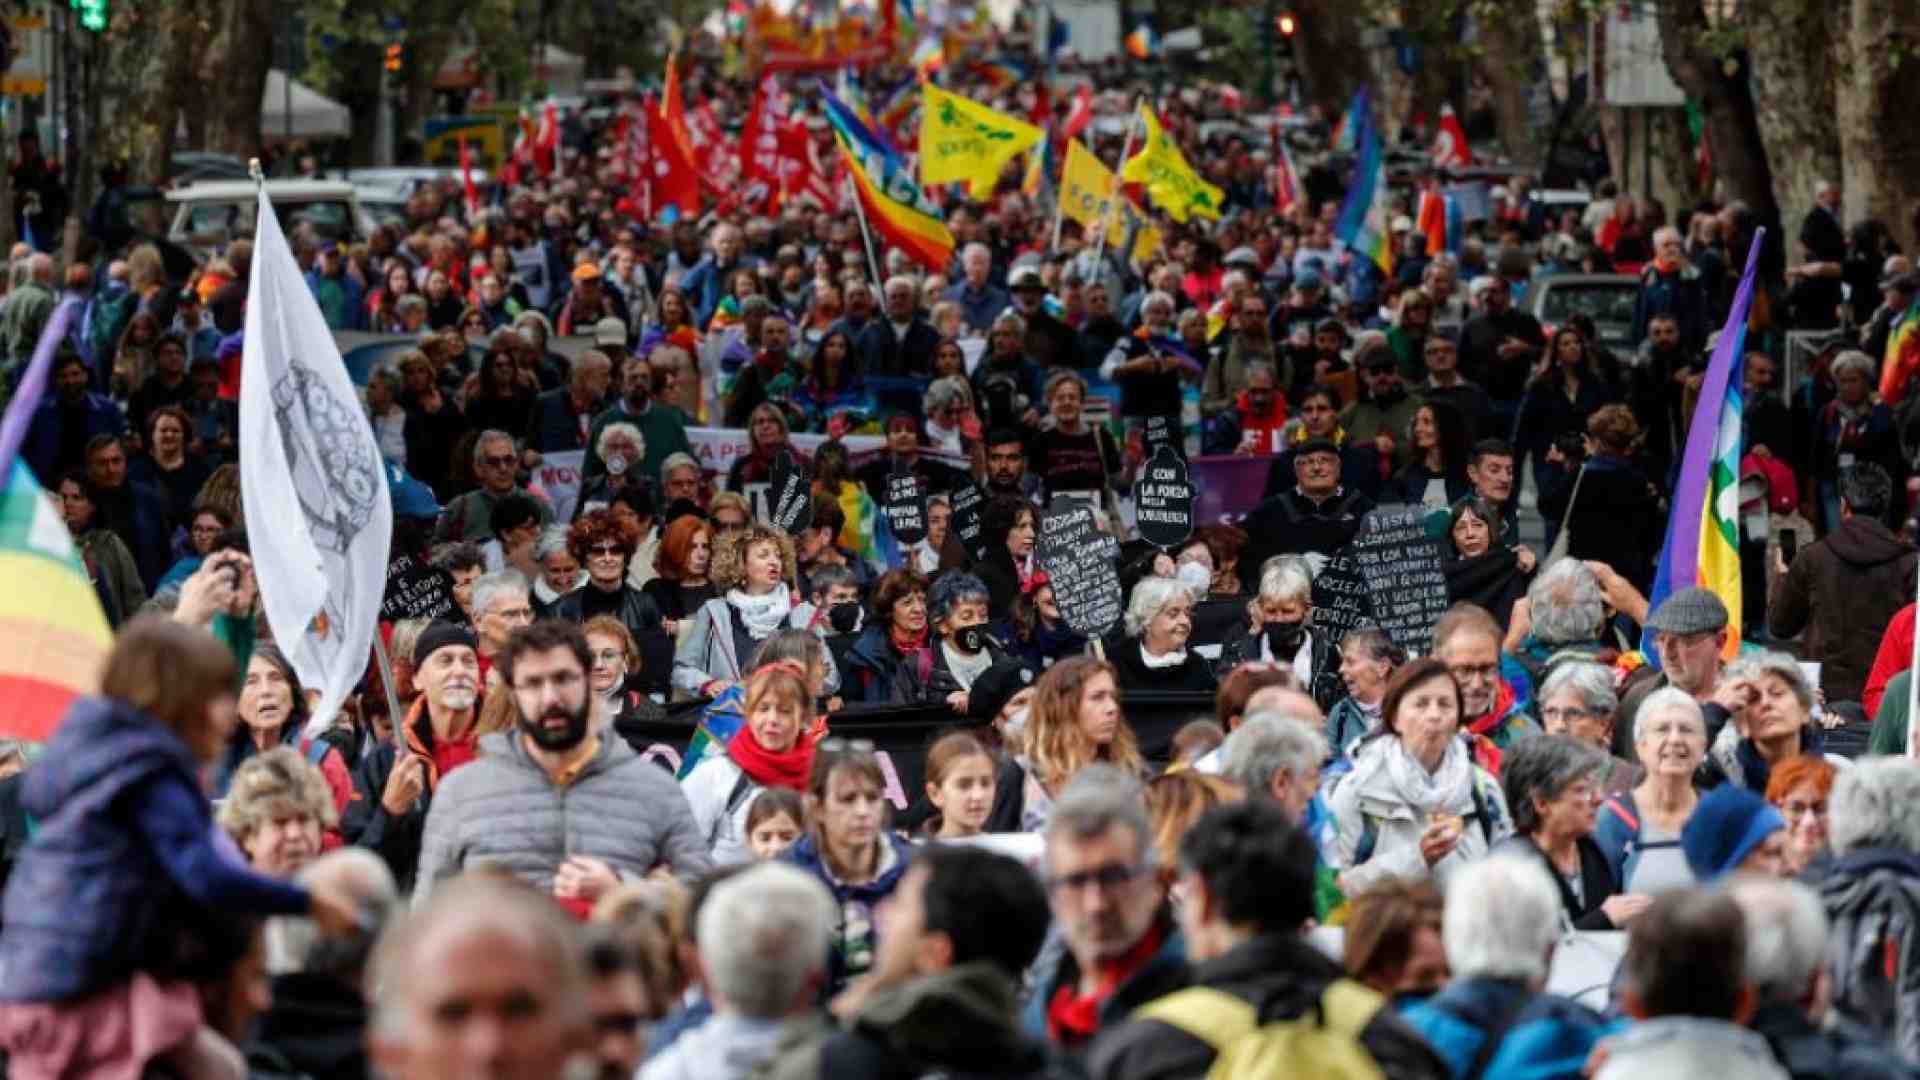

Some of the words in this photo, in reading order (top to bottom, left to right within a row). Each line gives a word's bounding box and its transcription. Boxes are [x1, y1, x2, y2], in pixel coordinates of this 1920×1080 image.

[1152, 468, 1176, 480] CON
[1142, 483, 1155, 497] LA
[1158, 484, 1189, 498] FORZA
[1369, 513, 1415, 533] BASTA
[1334, 596, 1361, 613] DAL
